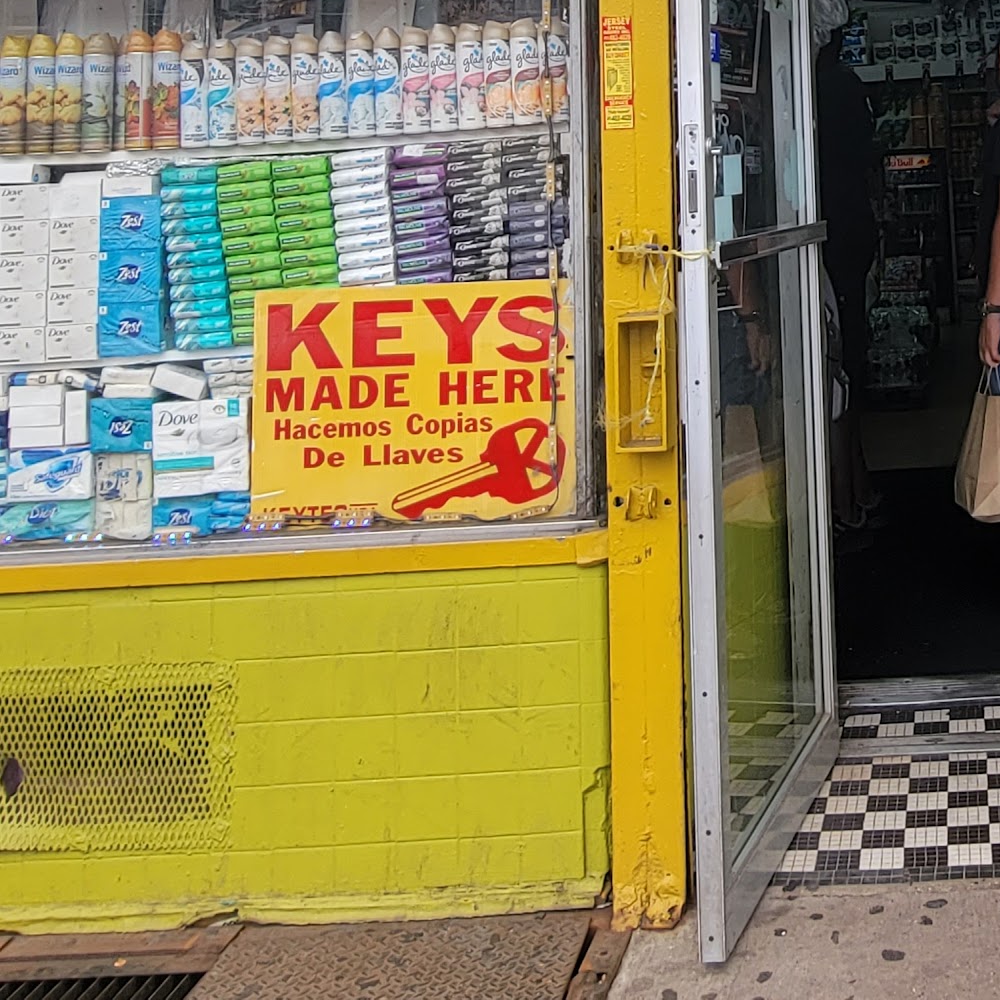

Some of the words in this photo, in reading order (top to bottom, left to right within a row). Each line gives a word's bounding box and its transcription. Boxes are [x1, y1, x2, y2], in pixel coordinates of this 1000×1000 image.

[120, 214, 144, 230] Zest
[116, 265, 142, 282] Zest
[117, 319, 143, 336] Zest
[266, 295, 566, 372] KEYS
[265, 373, 411, 413] MADE
[438, 367, 567, 406] HERE
[159, 410, 198, 427] Dove
[274, 417, 392, 441] Hacemos
[406, 412, 494, 438] Copias
[303, 446, 345, 469] De
[363, 443, 464, 467] Llaves
[168, 511, 193, 525] Zest
